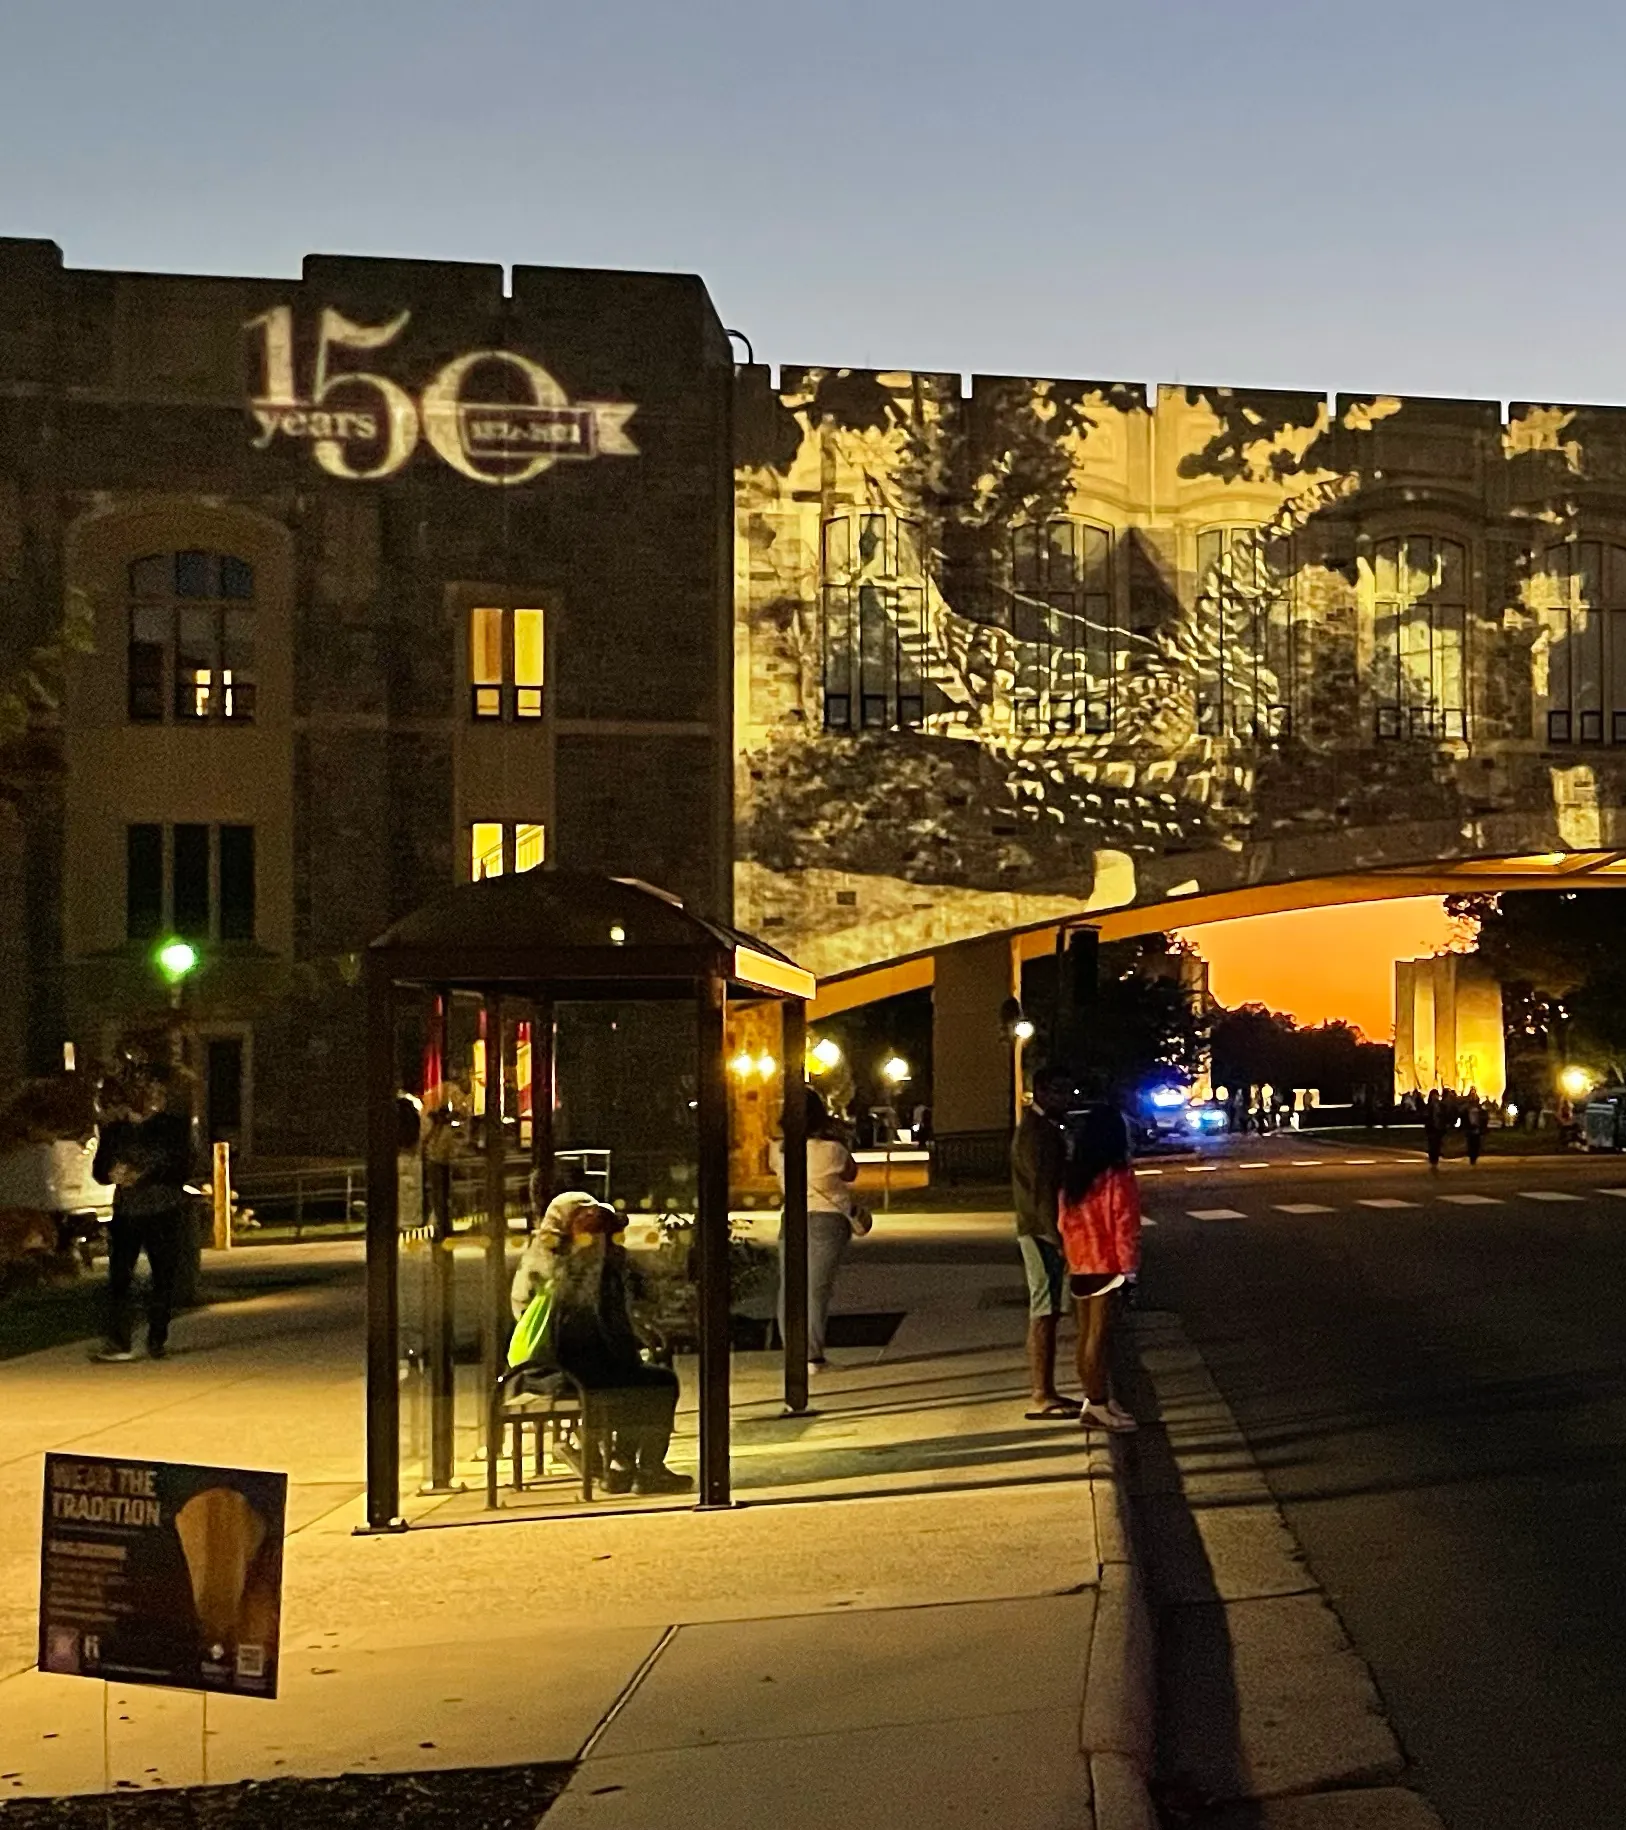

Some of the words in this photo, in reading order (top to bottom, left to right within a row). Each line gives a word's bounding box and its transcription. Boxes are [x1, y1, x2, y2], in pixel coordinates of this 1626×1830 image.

[243, 305, 568, 485] 150
[252, 407, 378, 448] years
[115, 1467, 158, 1497] THE
[52, 1491, 161, 1527] TRADITION
